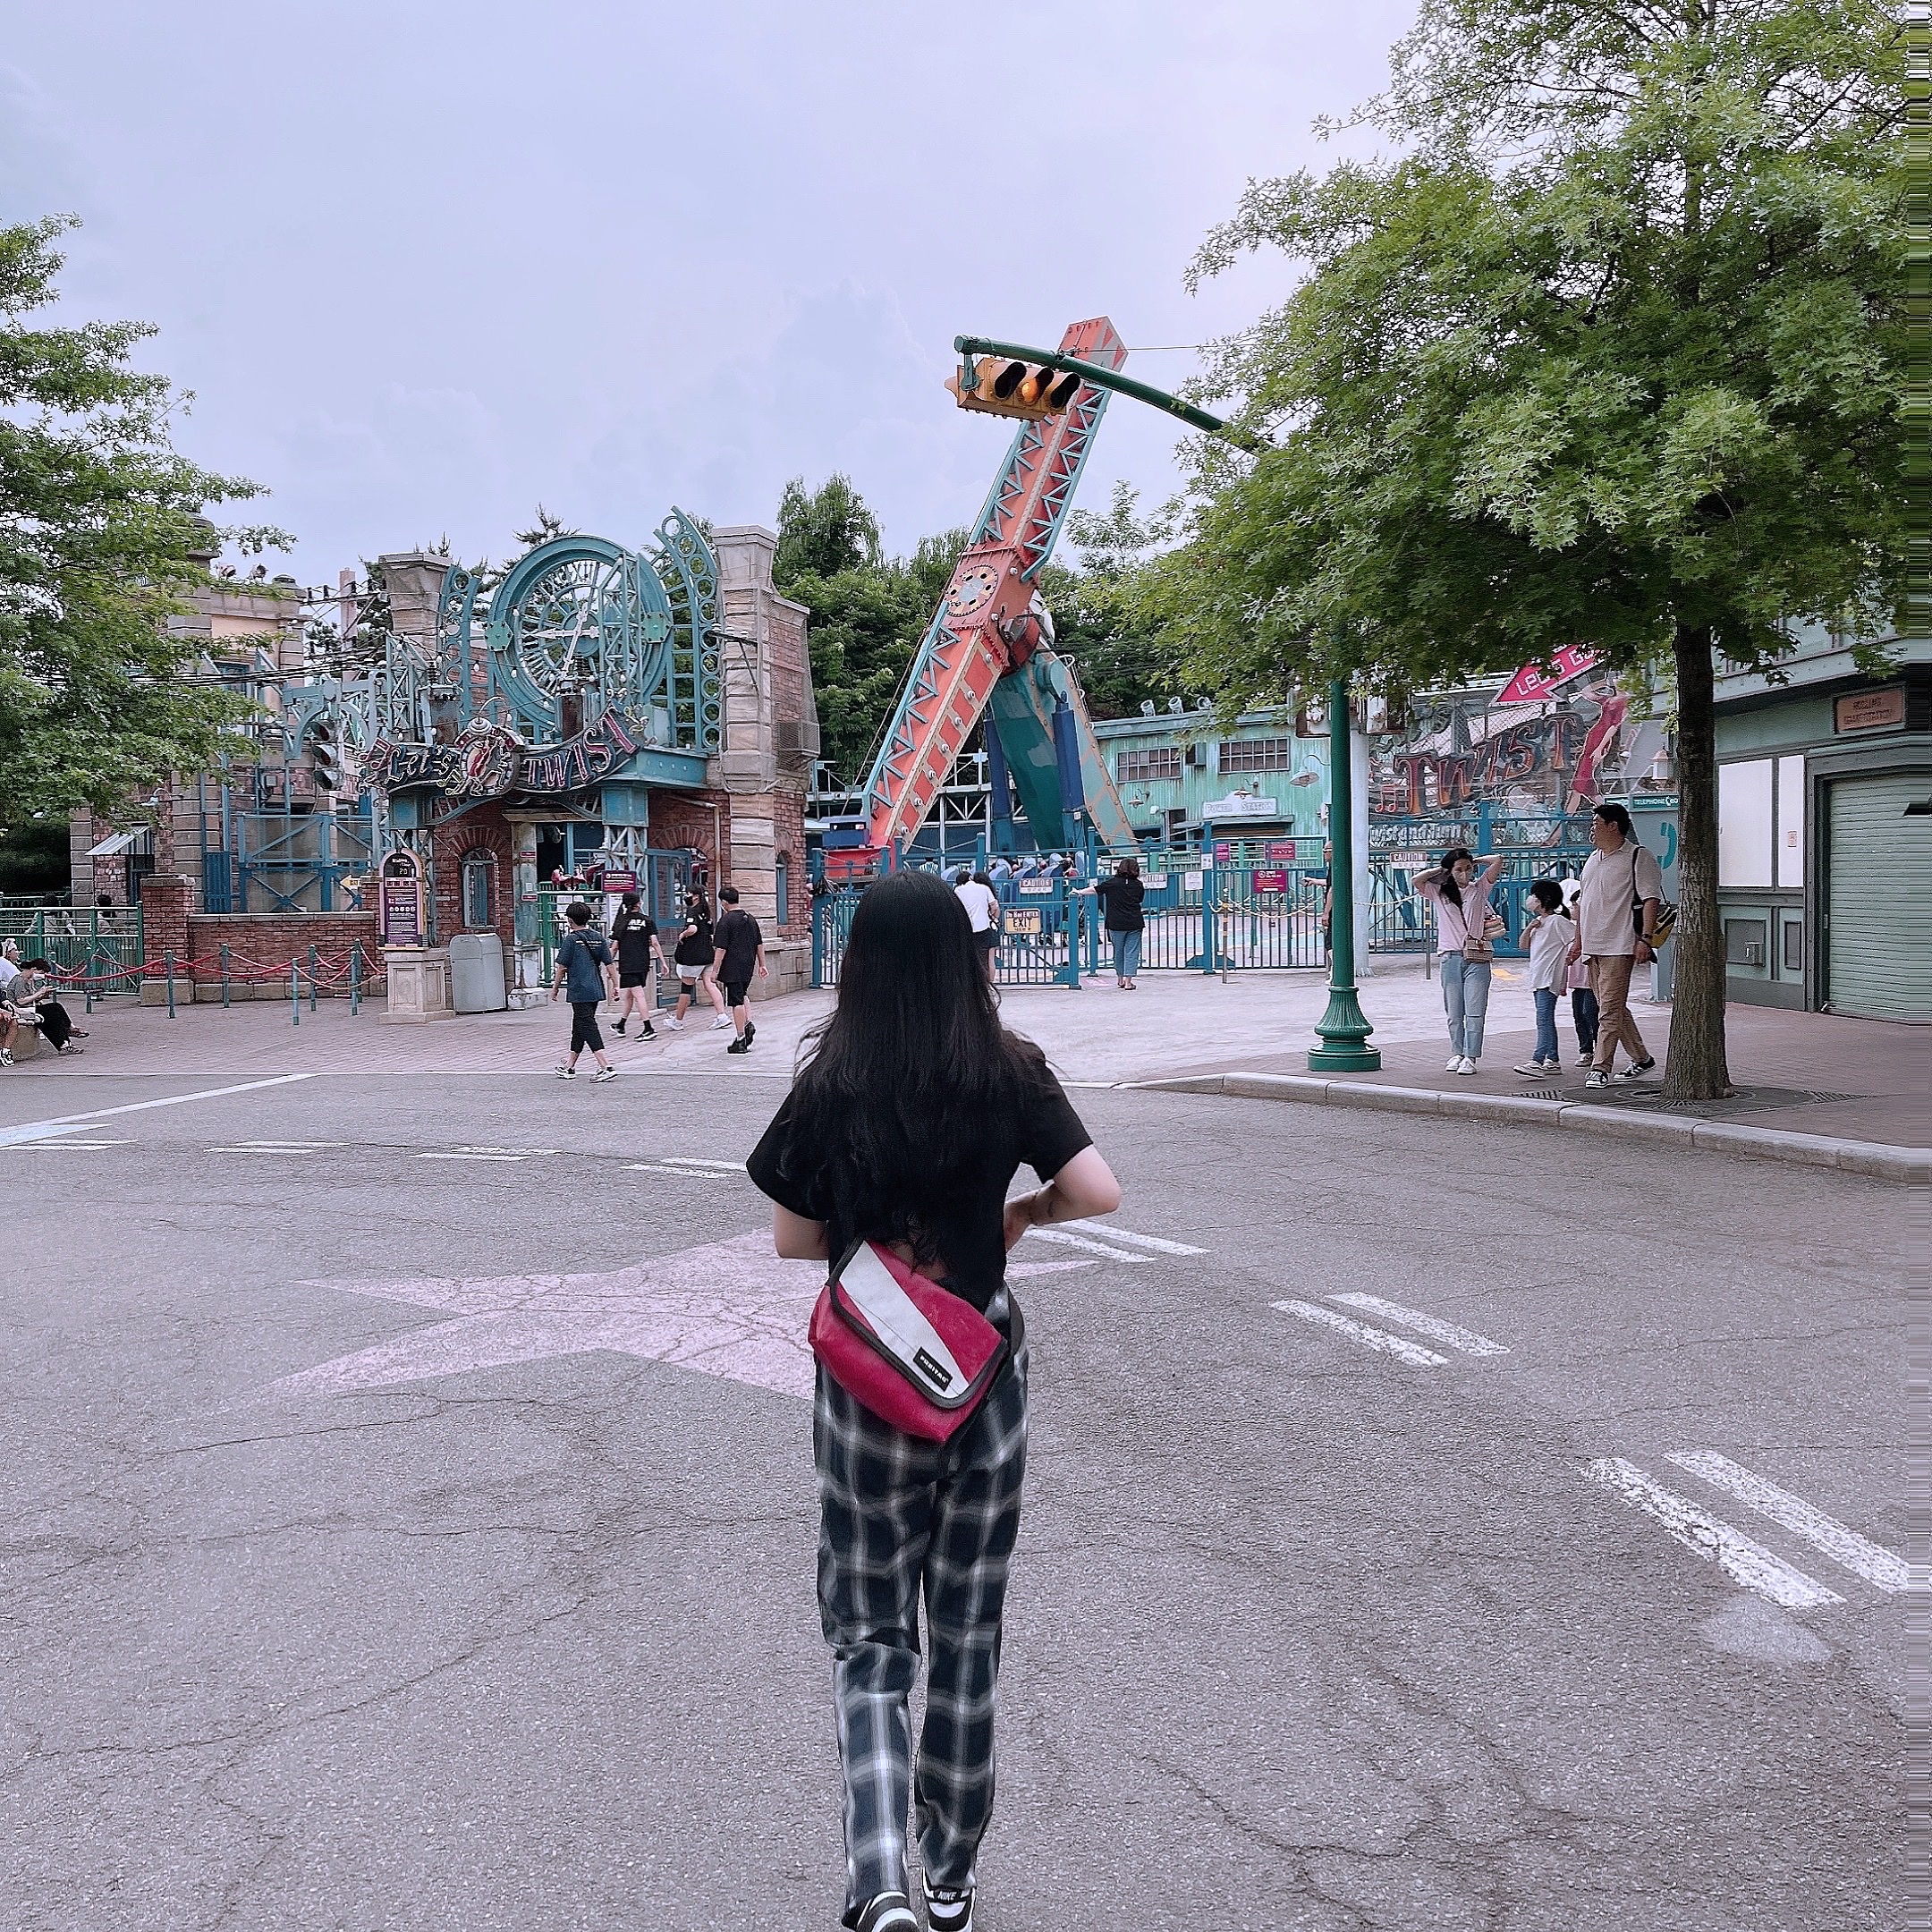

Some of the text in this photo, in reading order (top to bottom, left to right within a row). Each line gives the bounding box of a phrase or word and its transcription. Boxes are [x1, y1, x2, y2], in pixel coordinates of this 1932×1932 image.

[384, 705, 639, 788] Let's TWIST
[1394, 712, 1583, 817] TWIST
[1205, 801, 1274, 814] POWER STATION
[1394, 852, 1424, 862] CAUTION
[1022, 879, 1050, 887] CAUTION
[1013, 918, 1033, 928] EXIT
[937, 1890, 957, 1902] NIKE
